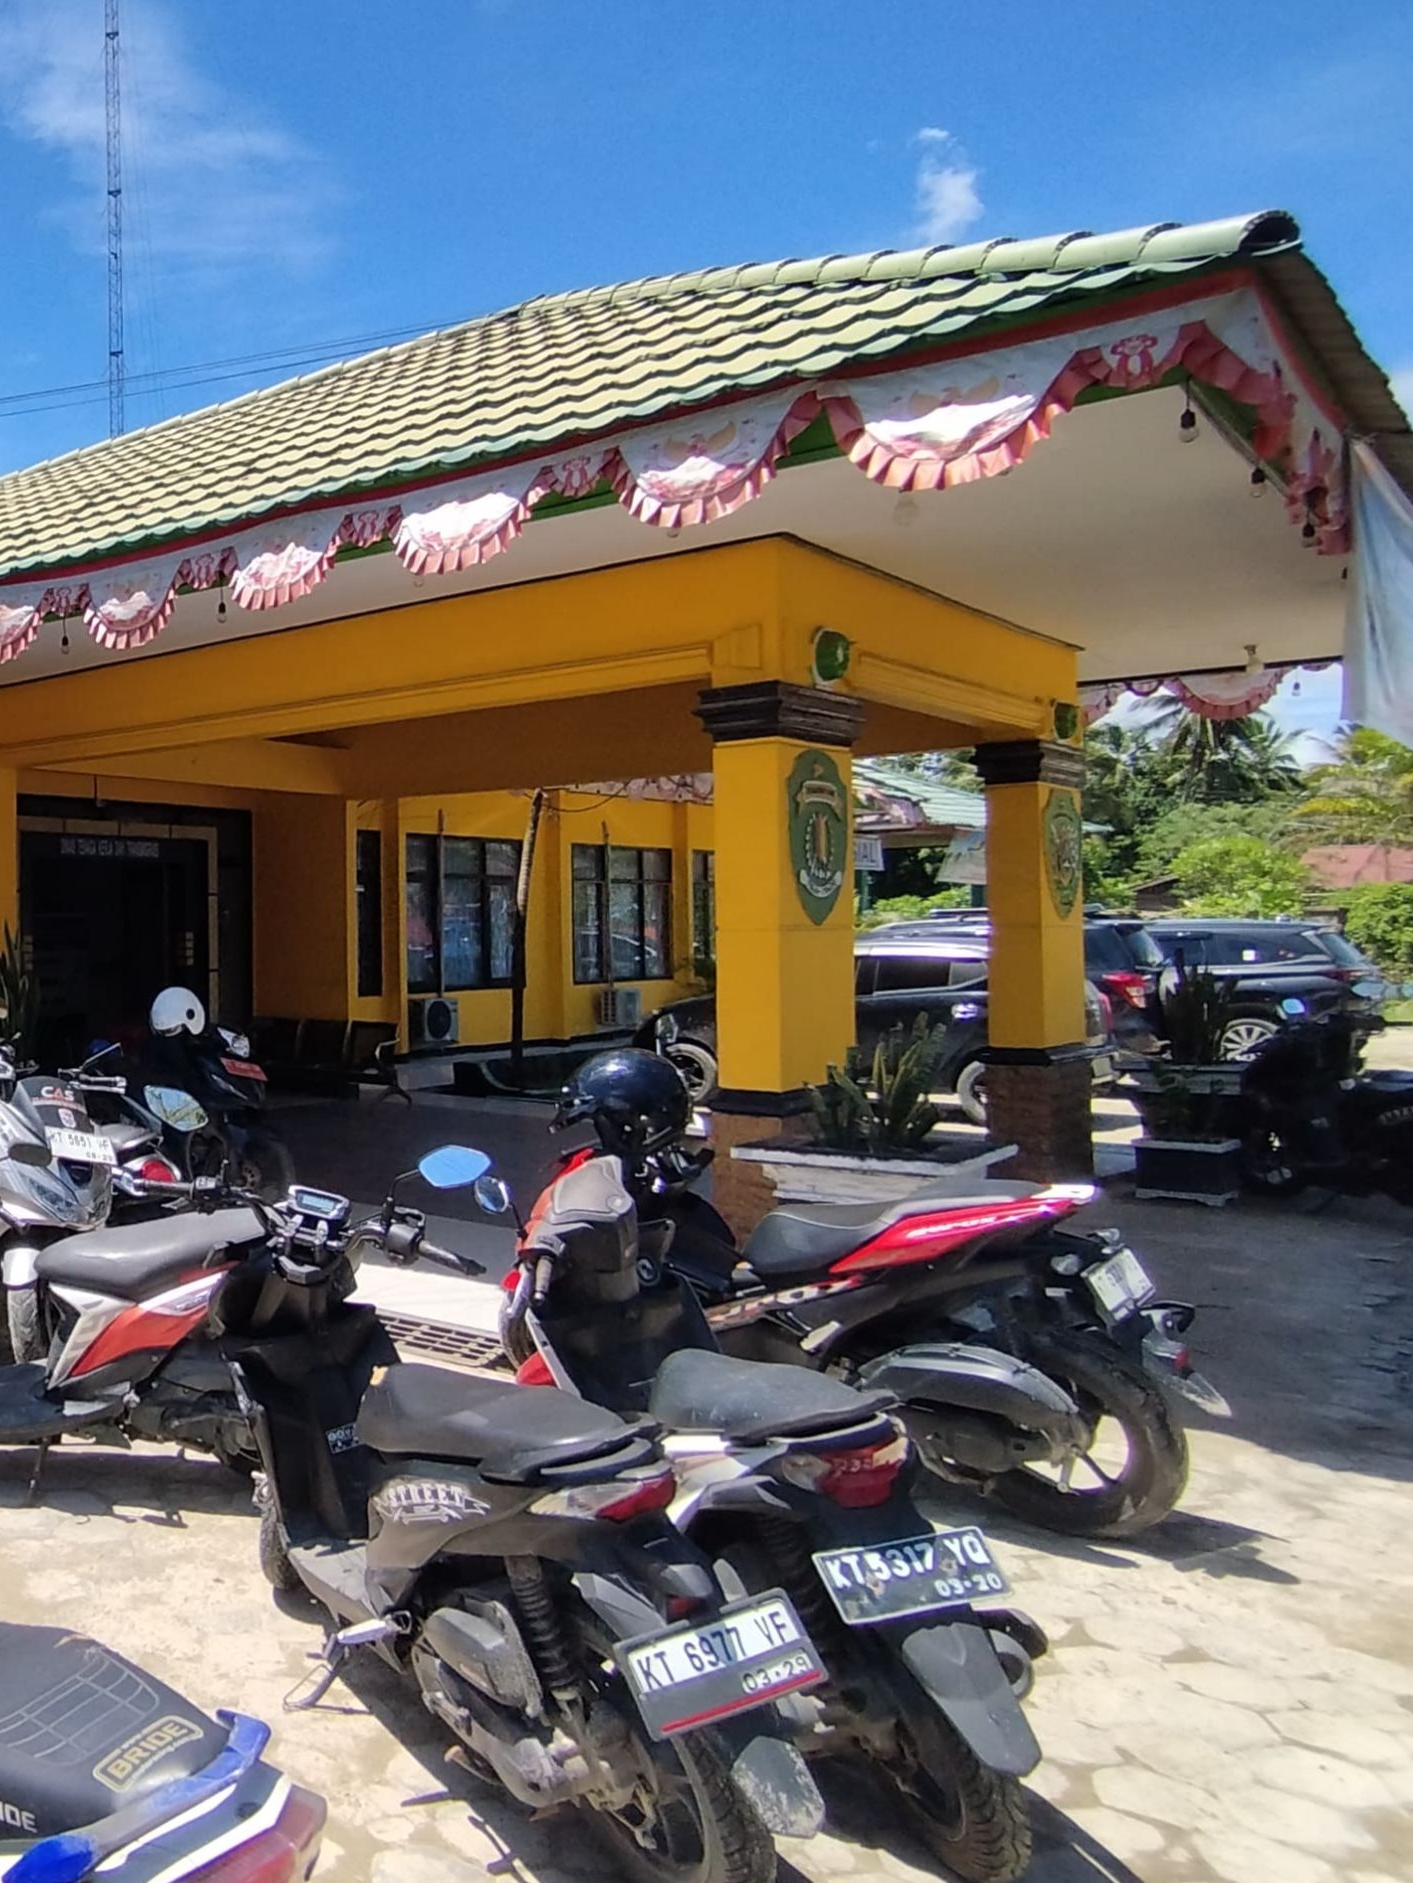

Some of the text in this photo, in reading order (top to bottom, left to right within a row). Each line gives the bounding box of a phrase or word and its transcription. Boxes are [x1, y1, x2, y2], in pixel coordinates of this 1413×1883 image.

[387, 1483, 464, 1508] STREET
[824, 1554, 865, 1589] KT
[863, 1542, 935, 1581] 5317
[636, 1611, 787, 1692] KT 6977 VF
[105, 1720, 190, 1781] BRIDE
